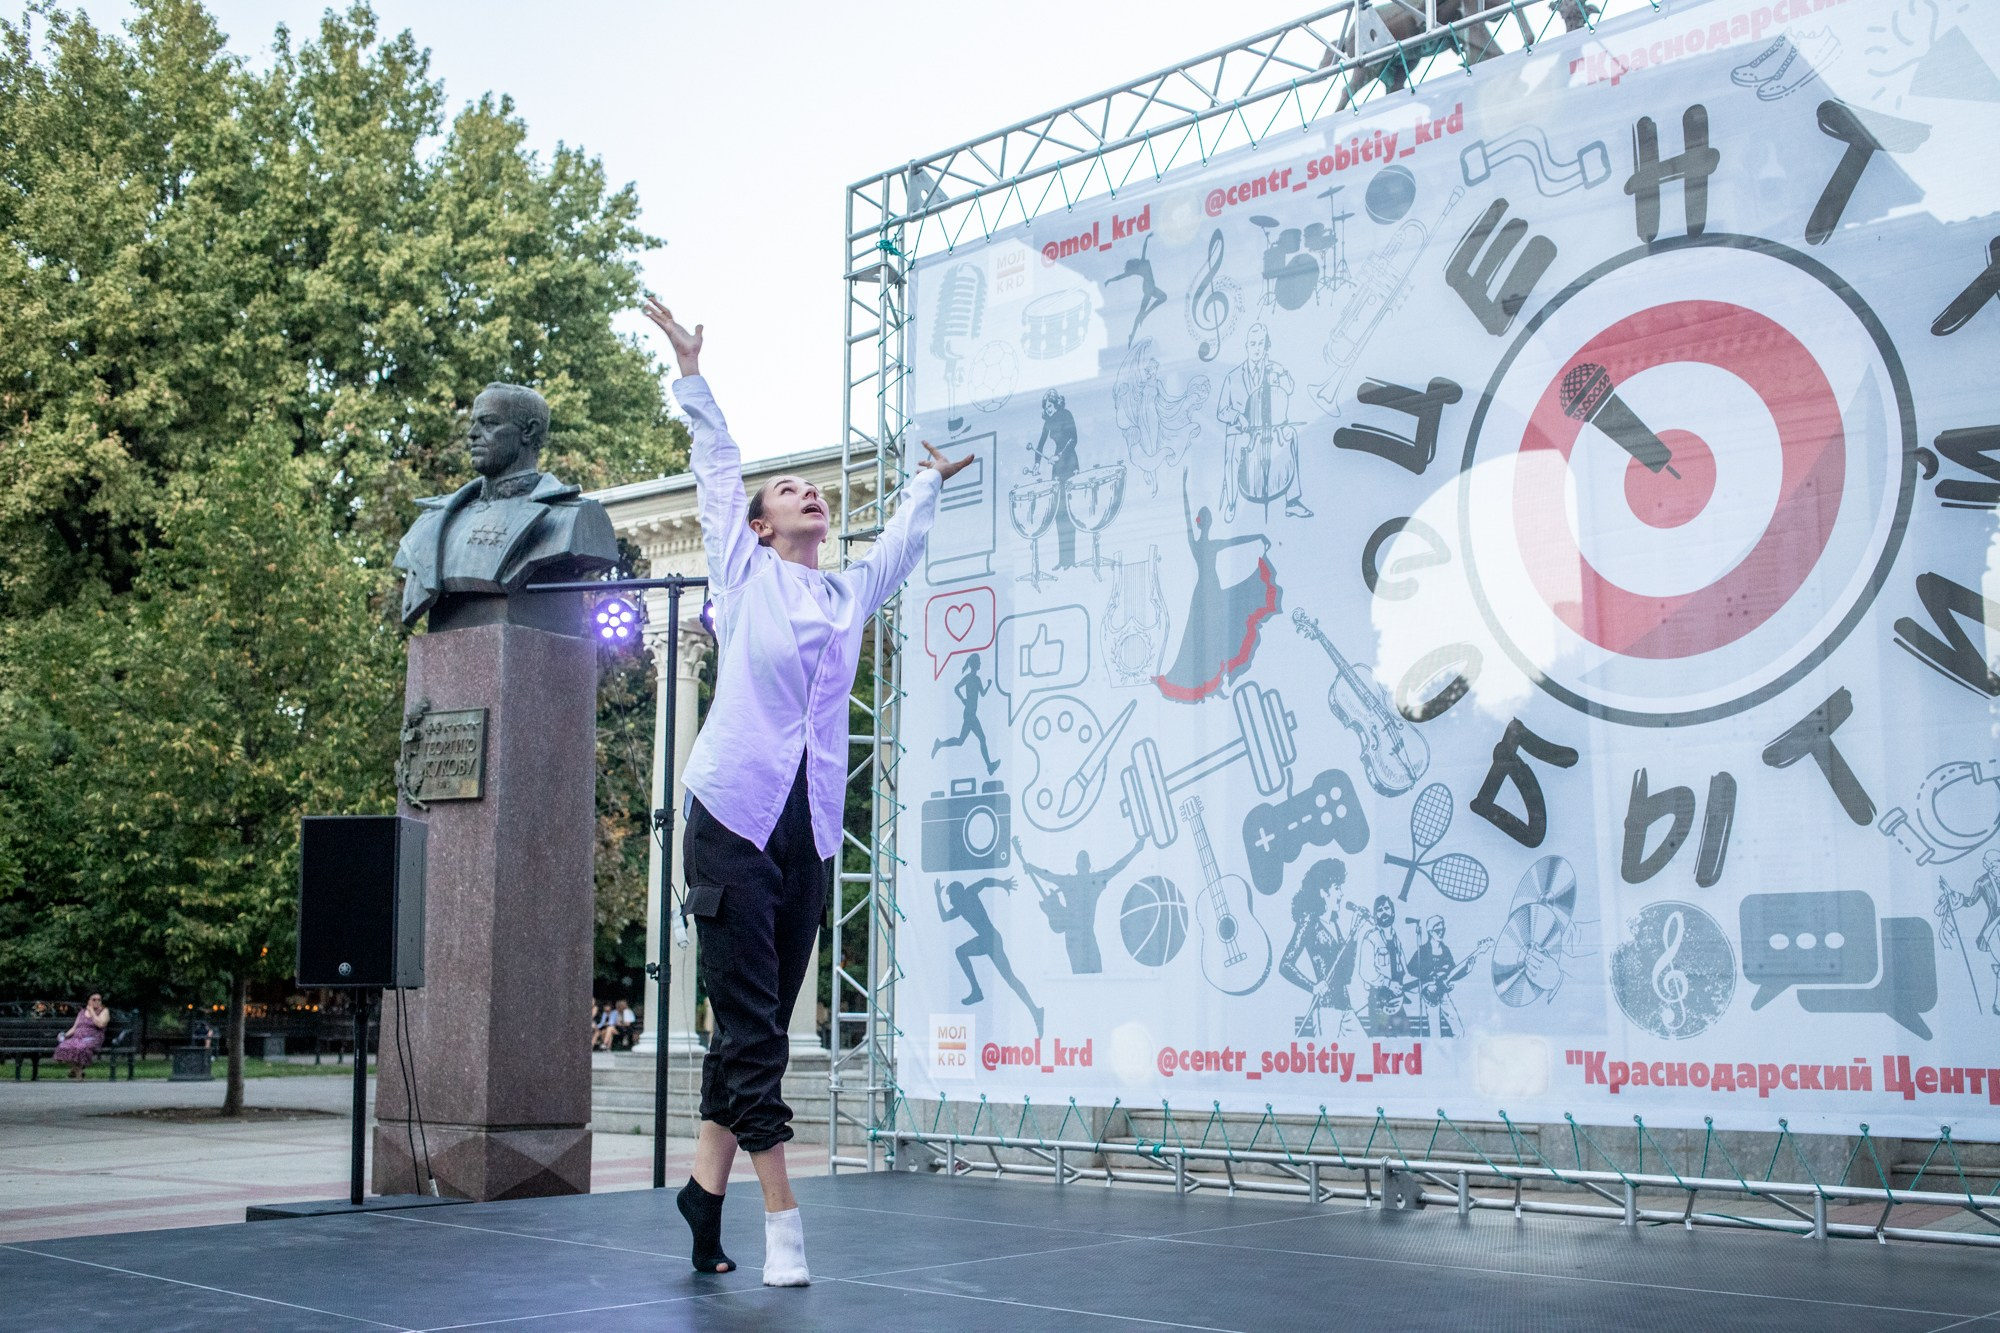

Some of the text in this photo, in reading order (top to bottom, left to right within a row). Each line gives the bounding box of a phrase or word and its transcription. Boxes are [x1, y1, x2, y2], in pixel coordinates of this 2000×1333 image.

[1569, 0, 1848, 87] "Краснодарск
[1205, 103, 1464, 217] @centr_sobitiy_krd
[1041, 204, 1151, 269] @mol_krd
[996, 249, 1025, 270] МОЛ
[996, 275, 1025, 295] KRD
[938, 1026, 967, 1040] МОЛ
[938, 1053, 967, 1066] KRD
[981, 1038, 1092, 1073] @mol_krd
[1157, 1042, 1422, 1082] @centr_sobitiy_krd
[1565, 1050, 1873, 1098] "Краснодарский
